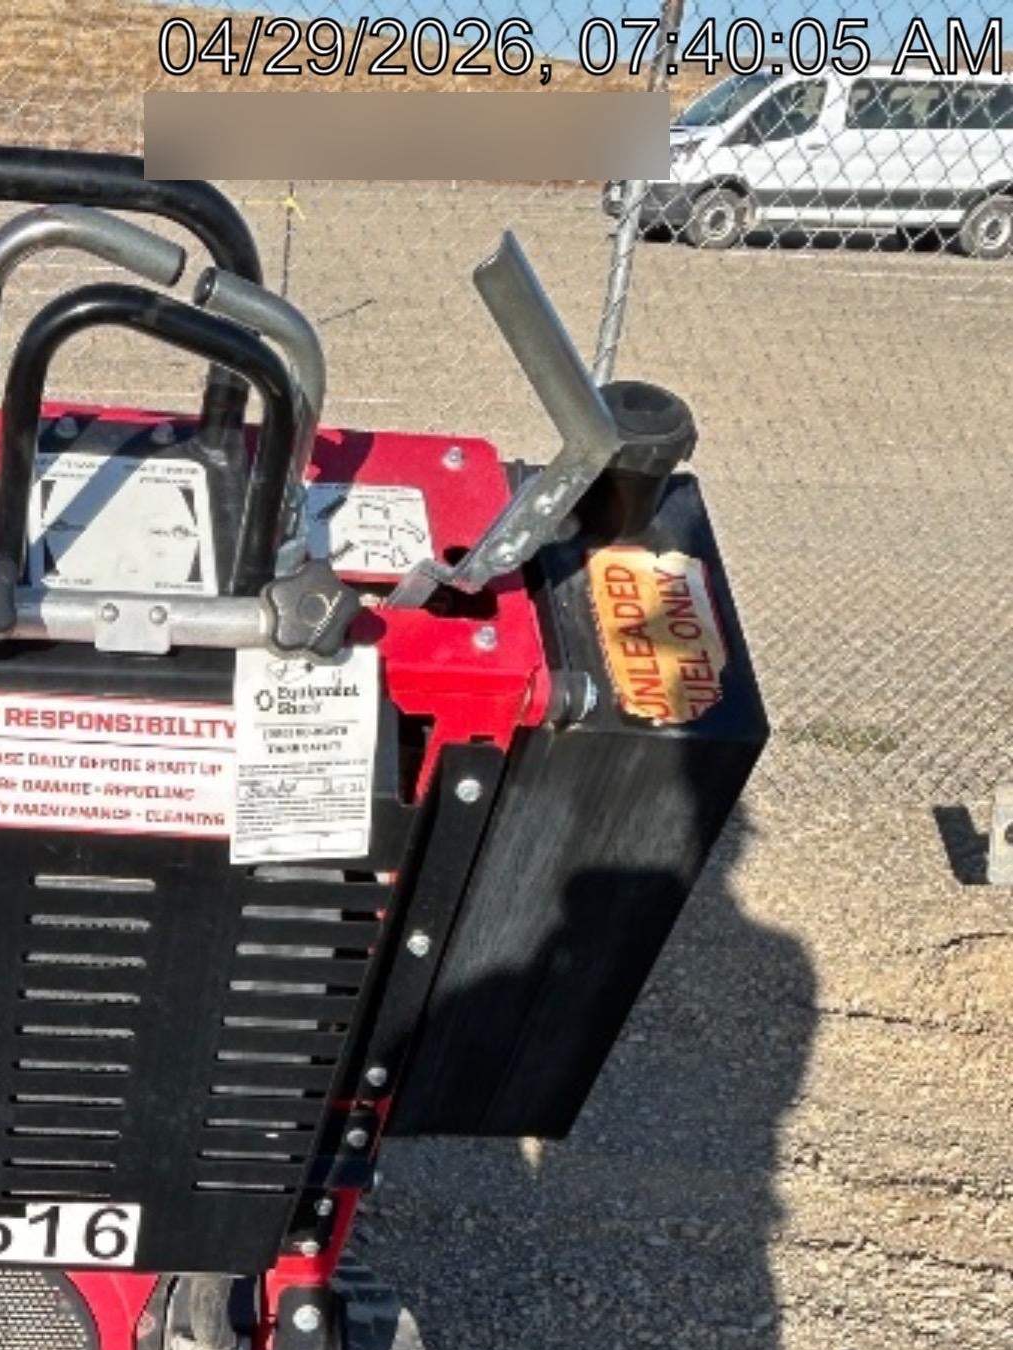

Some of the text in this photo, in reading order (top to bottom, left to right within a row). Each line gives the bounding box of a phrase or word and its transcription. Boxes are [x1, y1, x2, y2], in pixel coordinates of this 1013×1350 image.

[653, 566, 702, 641] ONLY
[604, 563, 671, 719] UNLEADED
[4, 707, 236, 739] RESPONSIBILITY
[28, 753, 77, 770] DAILY
[79, 755, 142, 773] BEFORE
[22, 778, 93, 797] DAMAGE
[13, 801, 133, 821] MAINTENANCE
[144, 809, 227, 827] CLEANING
